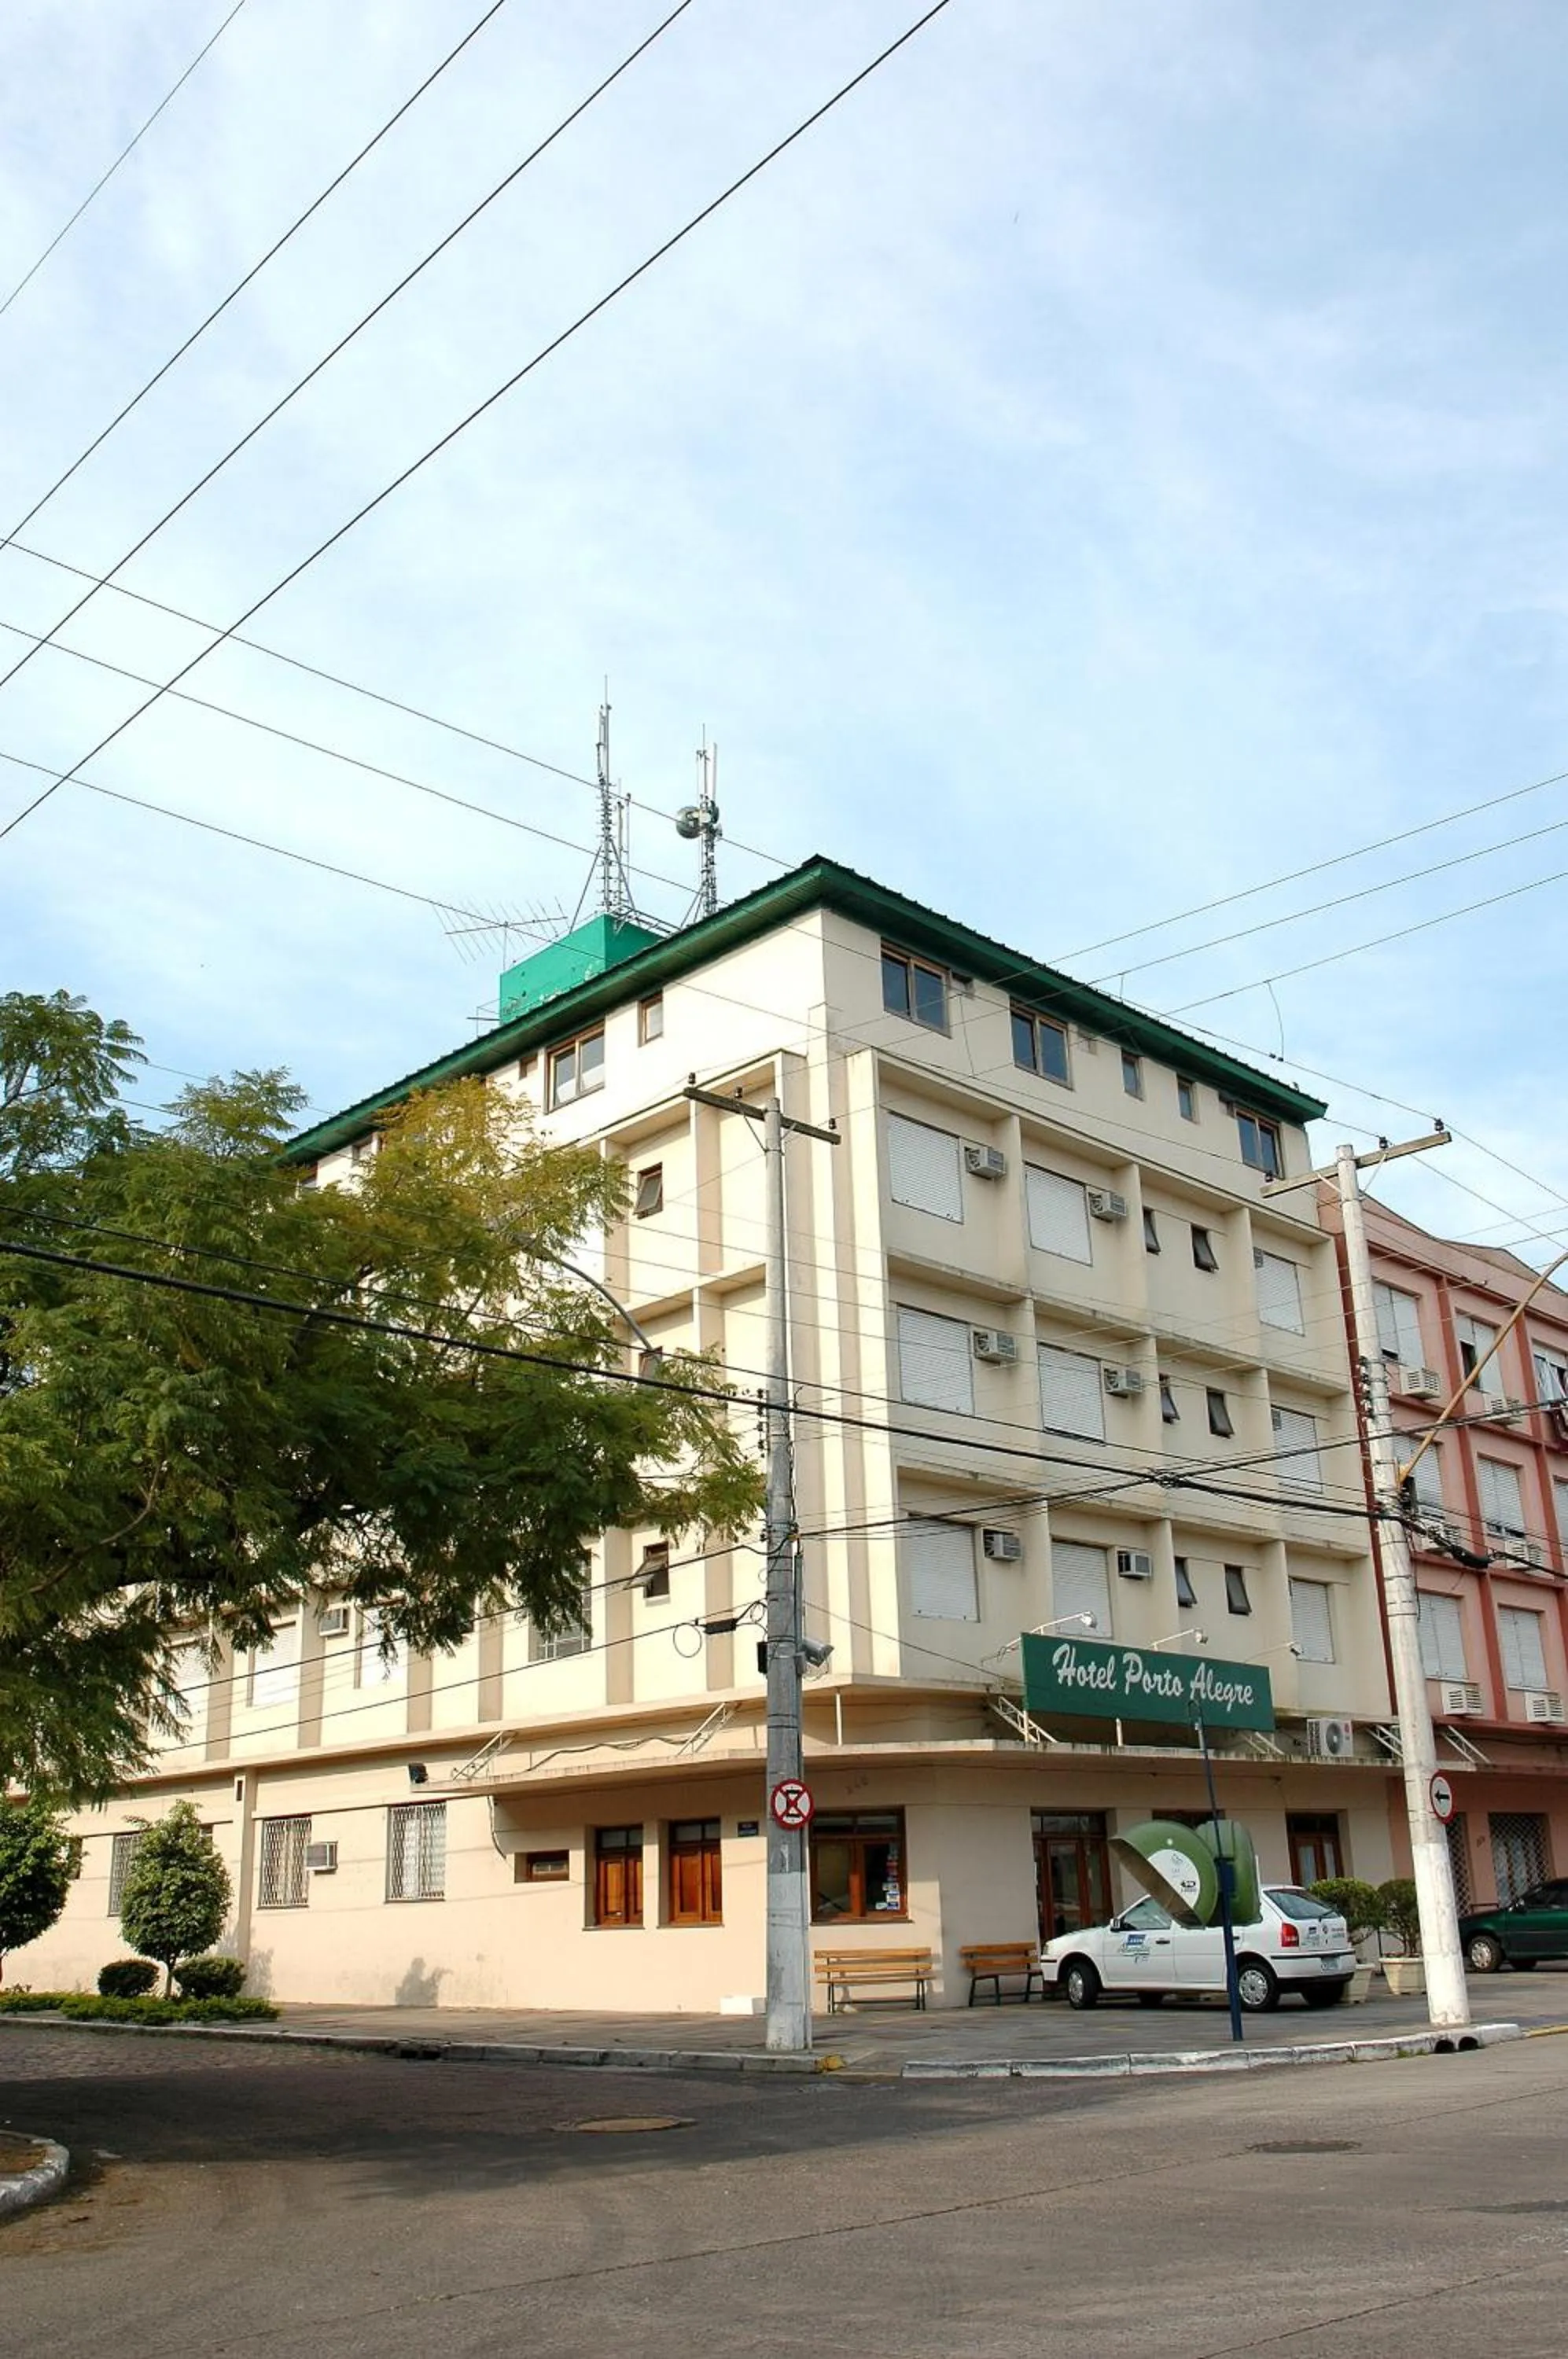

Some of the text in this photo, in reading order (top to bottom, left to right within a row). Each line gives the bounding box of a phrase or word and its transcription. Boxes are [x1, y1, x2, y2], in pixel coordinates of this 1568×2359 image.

[1052, 1643, 1254, 1712] Hotel Porto Alegre
